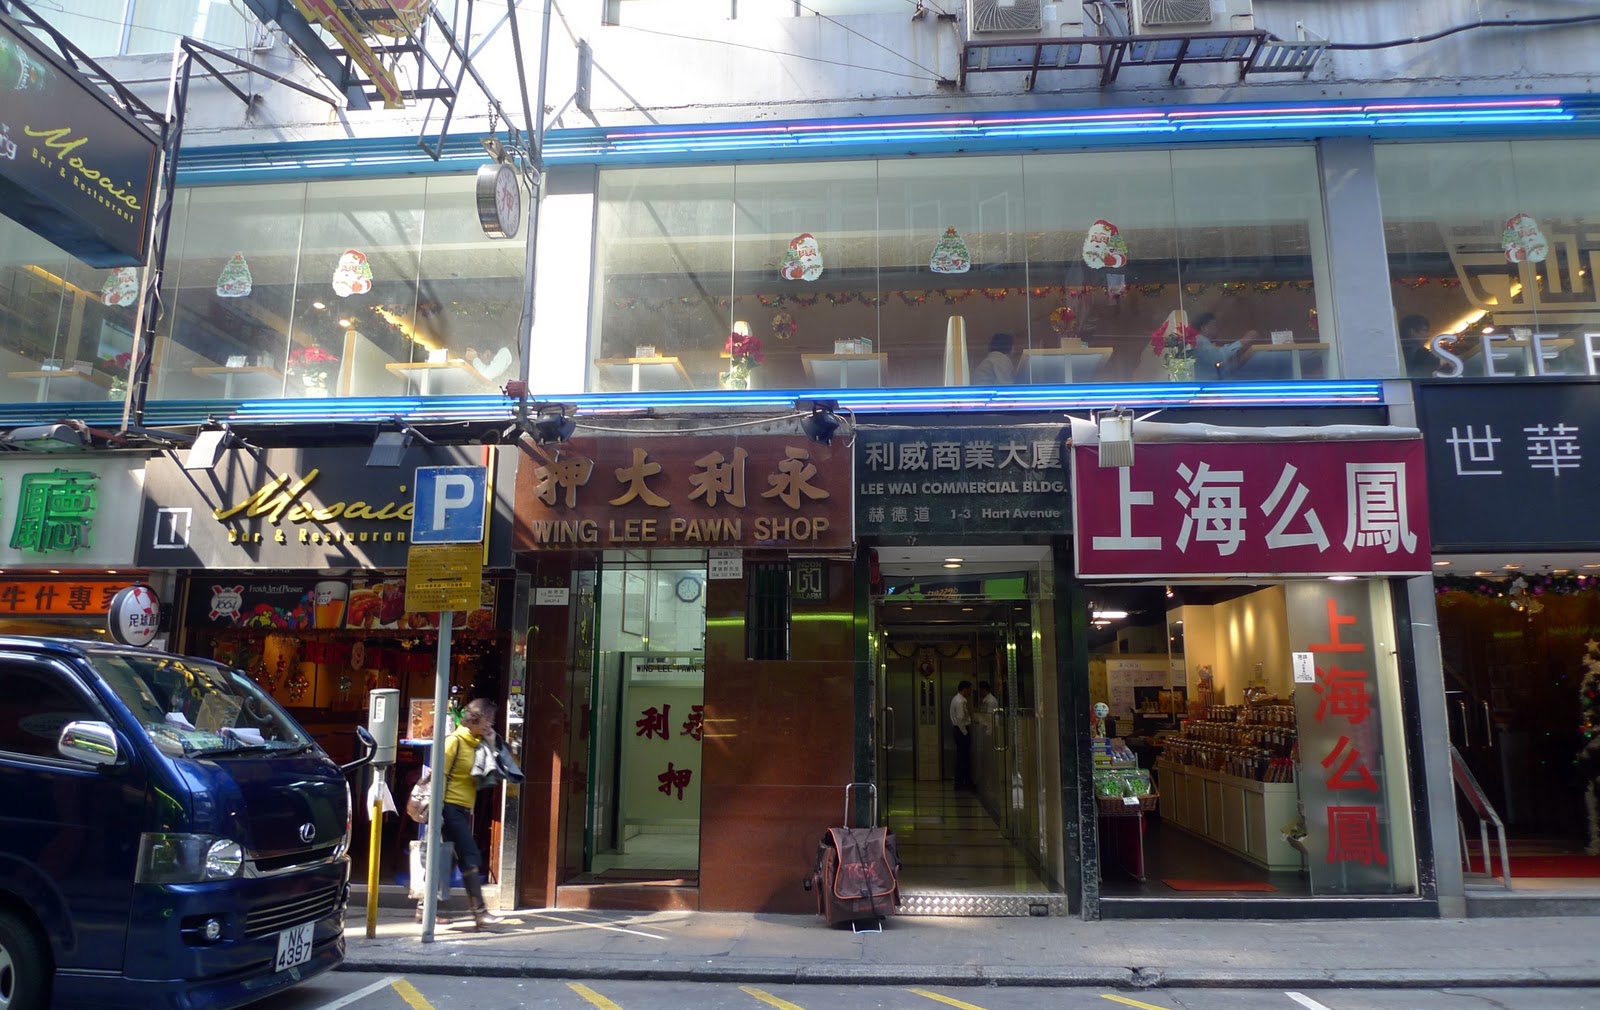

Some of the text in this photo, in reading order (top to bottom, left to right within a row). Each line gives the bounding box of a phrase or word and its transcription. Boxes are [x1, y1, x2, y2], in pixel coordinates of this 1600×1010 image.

[24, 125, 141, 210] Mosaic
[32, 148, 135, 224] Bar & Restaurant
[865, 440, 1063, 471] 利威商業大廈
[861, 481, 1068, 495] LEE WAI COMMERCIAL BLDG.
[433, 474, 475, 531] P
[868, 506, 930, 523] 赫德道
[950, 508, 1060, 519] 1-3 Hart Avenue
[228, 528, 405, 543] Bar & Restauran
[532, 516, 830, 543] WING LEE PAWN SHOP
[636, 664, 654, 673] WING
[657, 664, 673, 672] LEE
[677, 664, 697, 672] PAWN
[288, 927, 305, 948] NK
[278, 941, 311, 968] 4397
